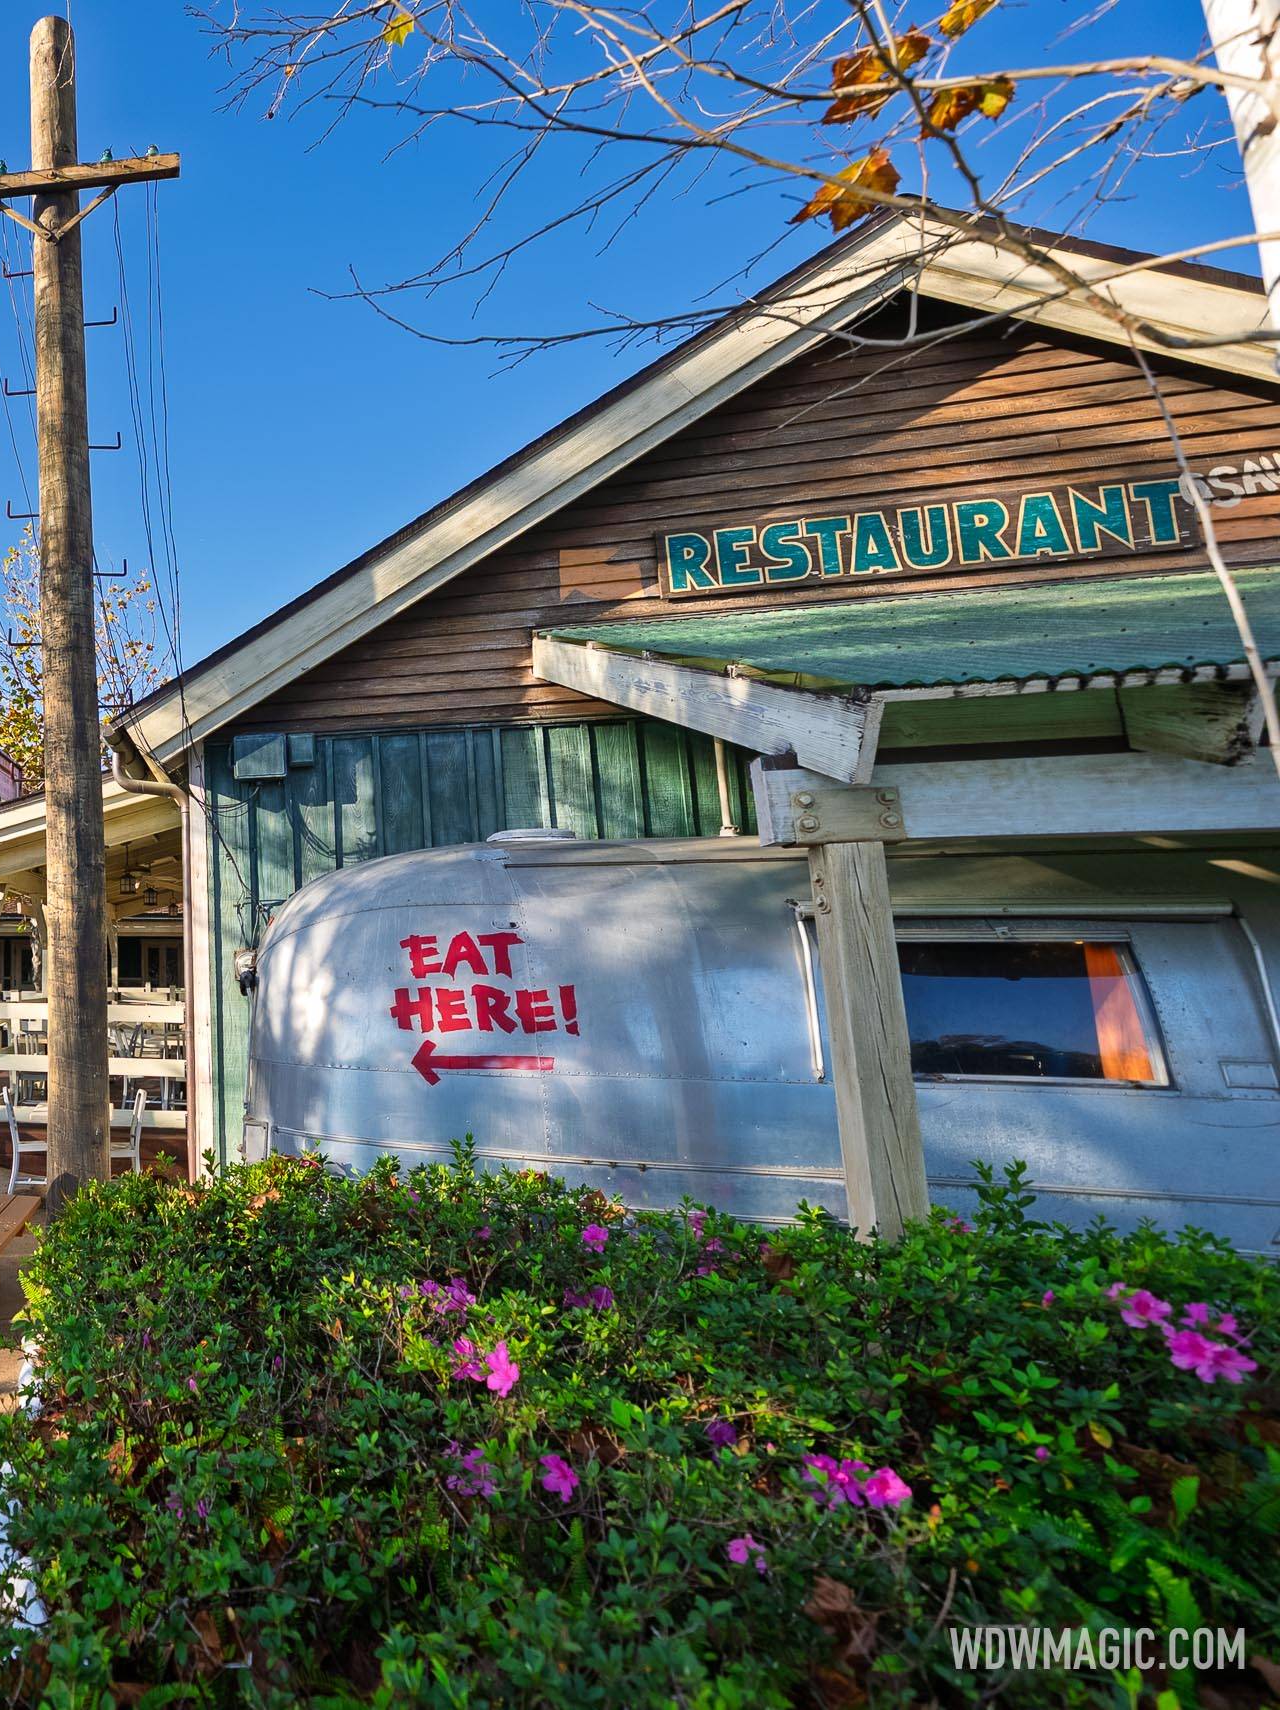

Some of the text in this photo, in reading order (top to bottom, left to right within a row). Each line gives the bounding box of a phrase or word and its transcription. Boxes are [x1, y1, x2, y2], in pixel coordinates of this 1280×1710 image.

[665, 480, 1180, 593] RESTAURANT
[399, 930, 525, 981] EAT
[390, 983, 580, 1037] HERE!
